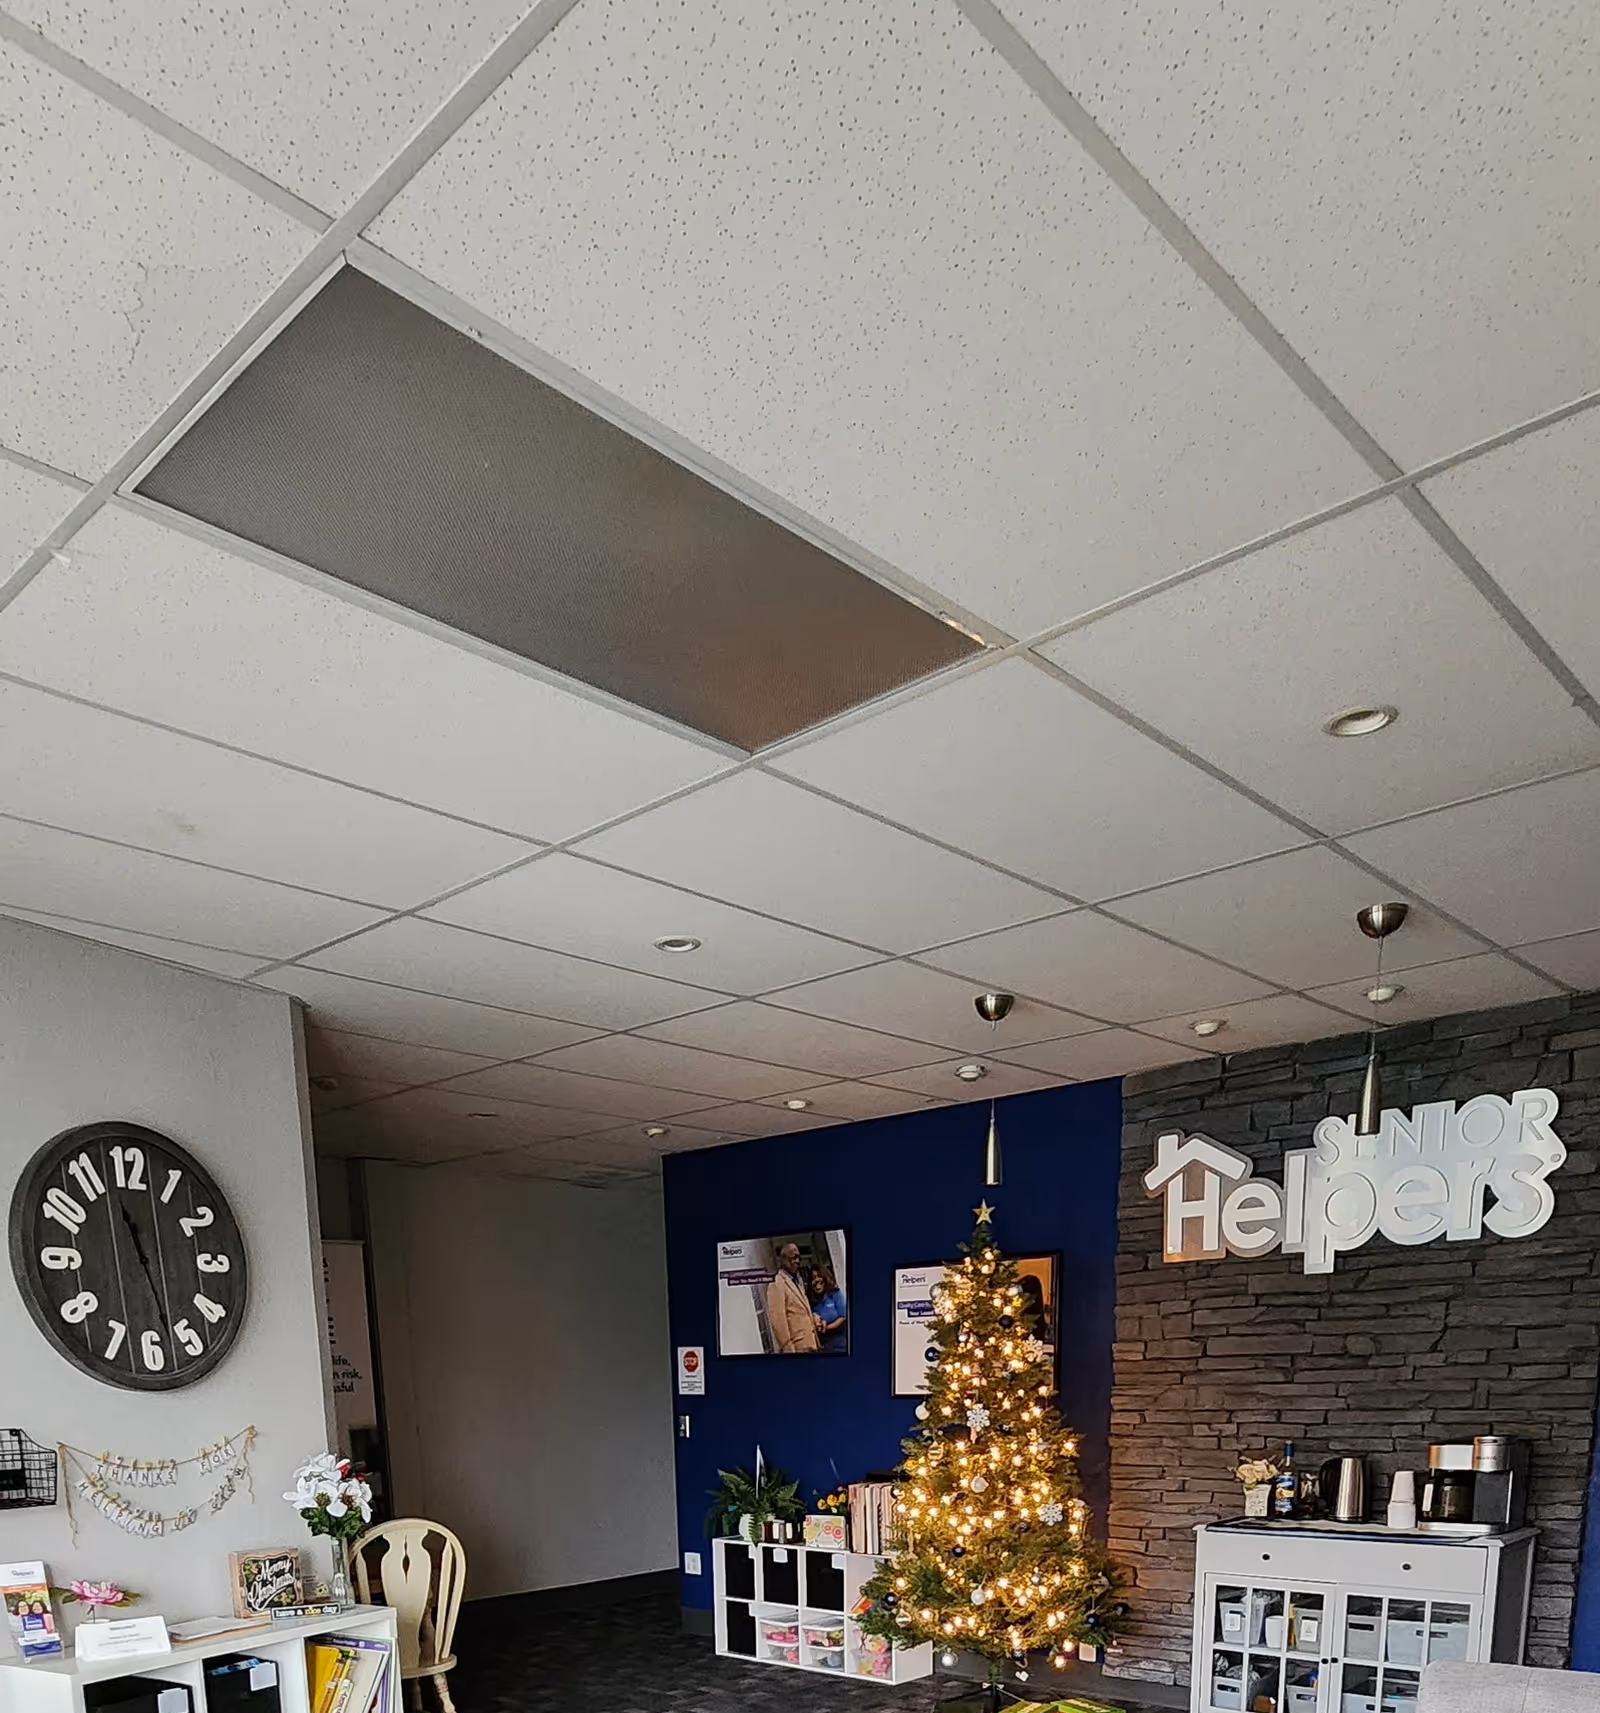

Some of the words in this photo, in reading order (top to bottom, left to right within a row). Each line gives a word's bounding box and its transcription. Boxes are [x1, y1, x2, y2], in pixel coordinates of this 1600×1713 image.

[1316, 1097, 1549, 1166] SENIOR
[68, 1152, 106, 1202] 11
[109, 1146, 147, 1190] 12
[160, 1169, 182, 1204] 1
[42, 1187, 87, 1235] 10
[179, 1206, 215, 1238] 2
[1160, 1148, 1546, 1270] Helpers
[40, 1246, 83, 1270] 9
[196, 1253, 230, 1273] 3
[60, 1291, 99, 1324] 8
[193, 1293, 227, 1324] 4
[104, 1319, 127, 1361] 7
[140, 1330, 165, 1371] 6
[173, 1318, 204, 1357] 5
[96, 1463, 174, 1481] THANKS
[200, 1447, 233, 1470] FOR
[78, 1482, 161, 1533] HELPING
[256, 1559, 292, 1581] Merry
[276, 1609, 296, 1617] have
[304, 1606, 321, 1614] nice
[322, 1605, 338, 1614] day
